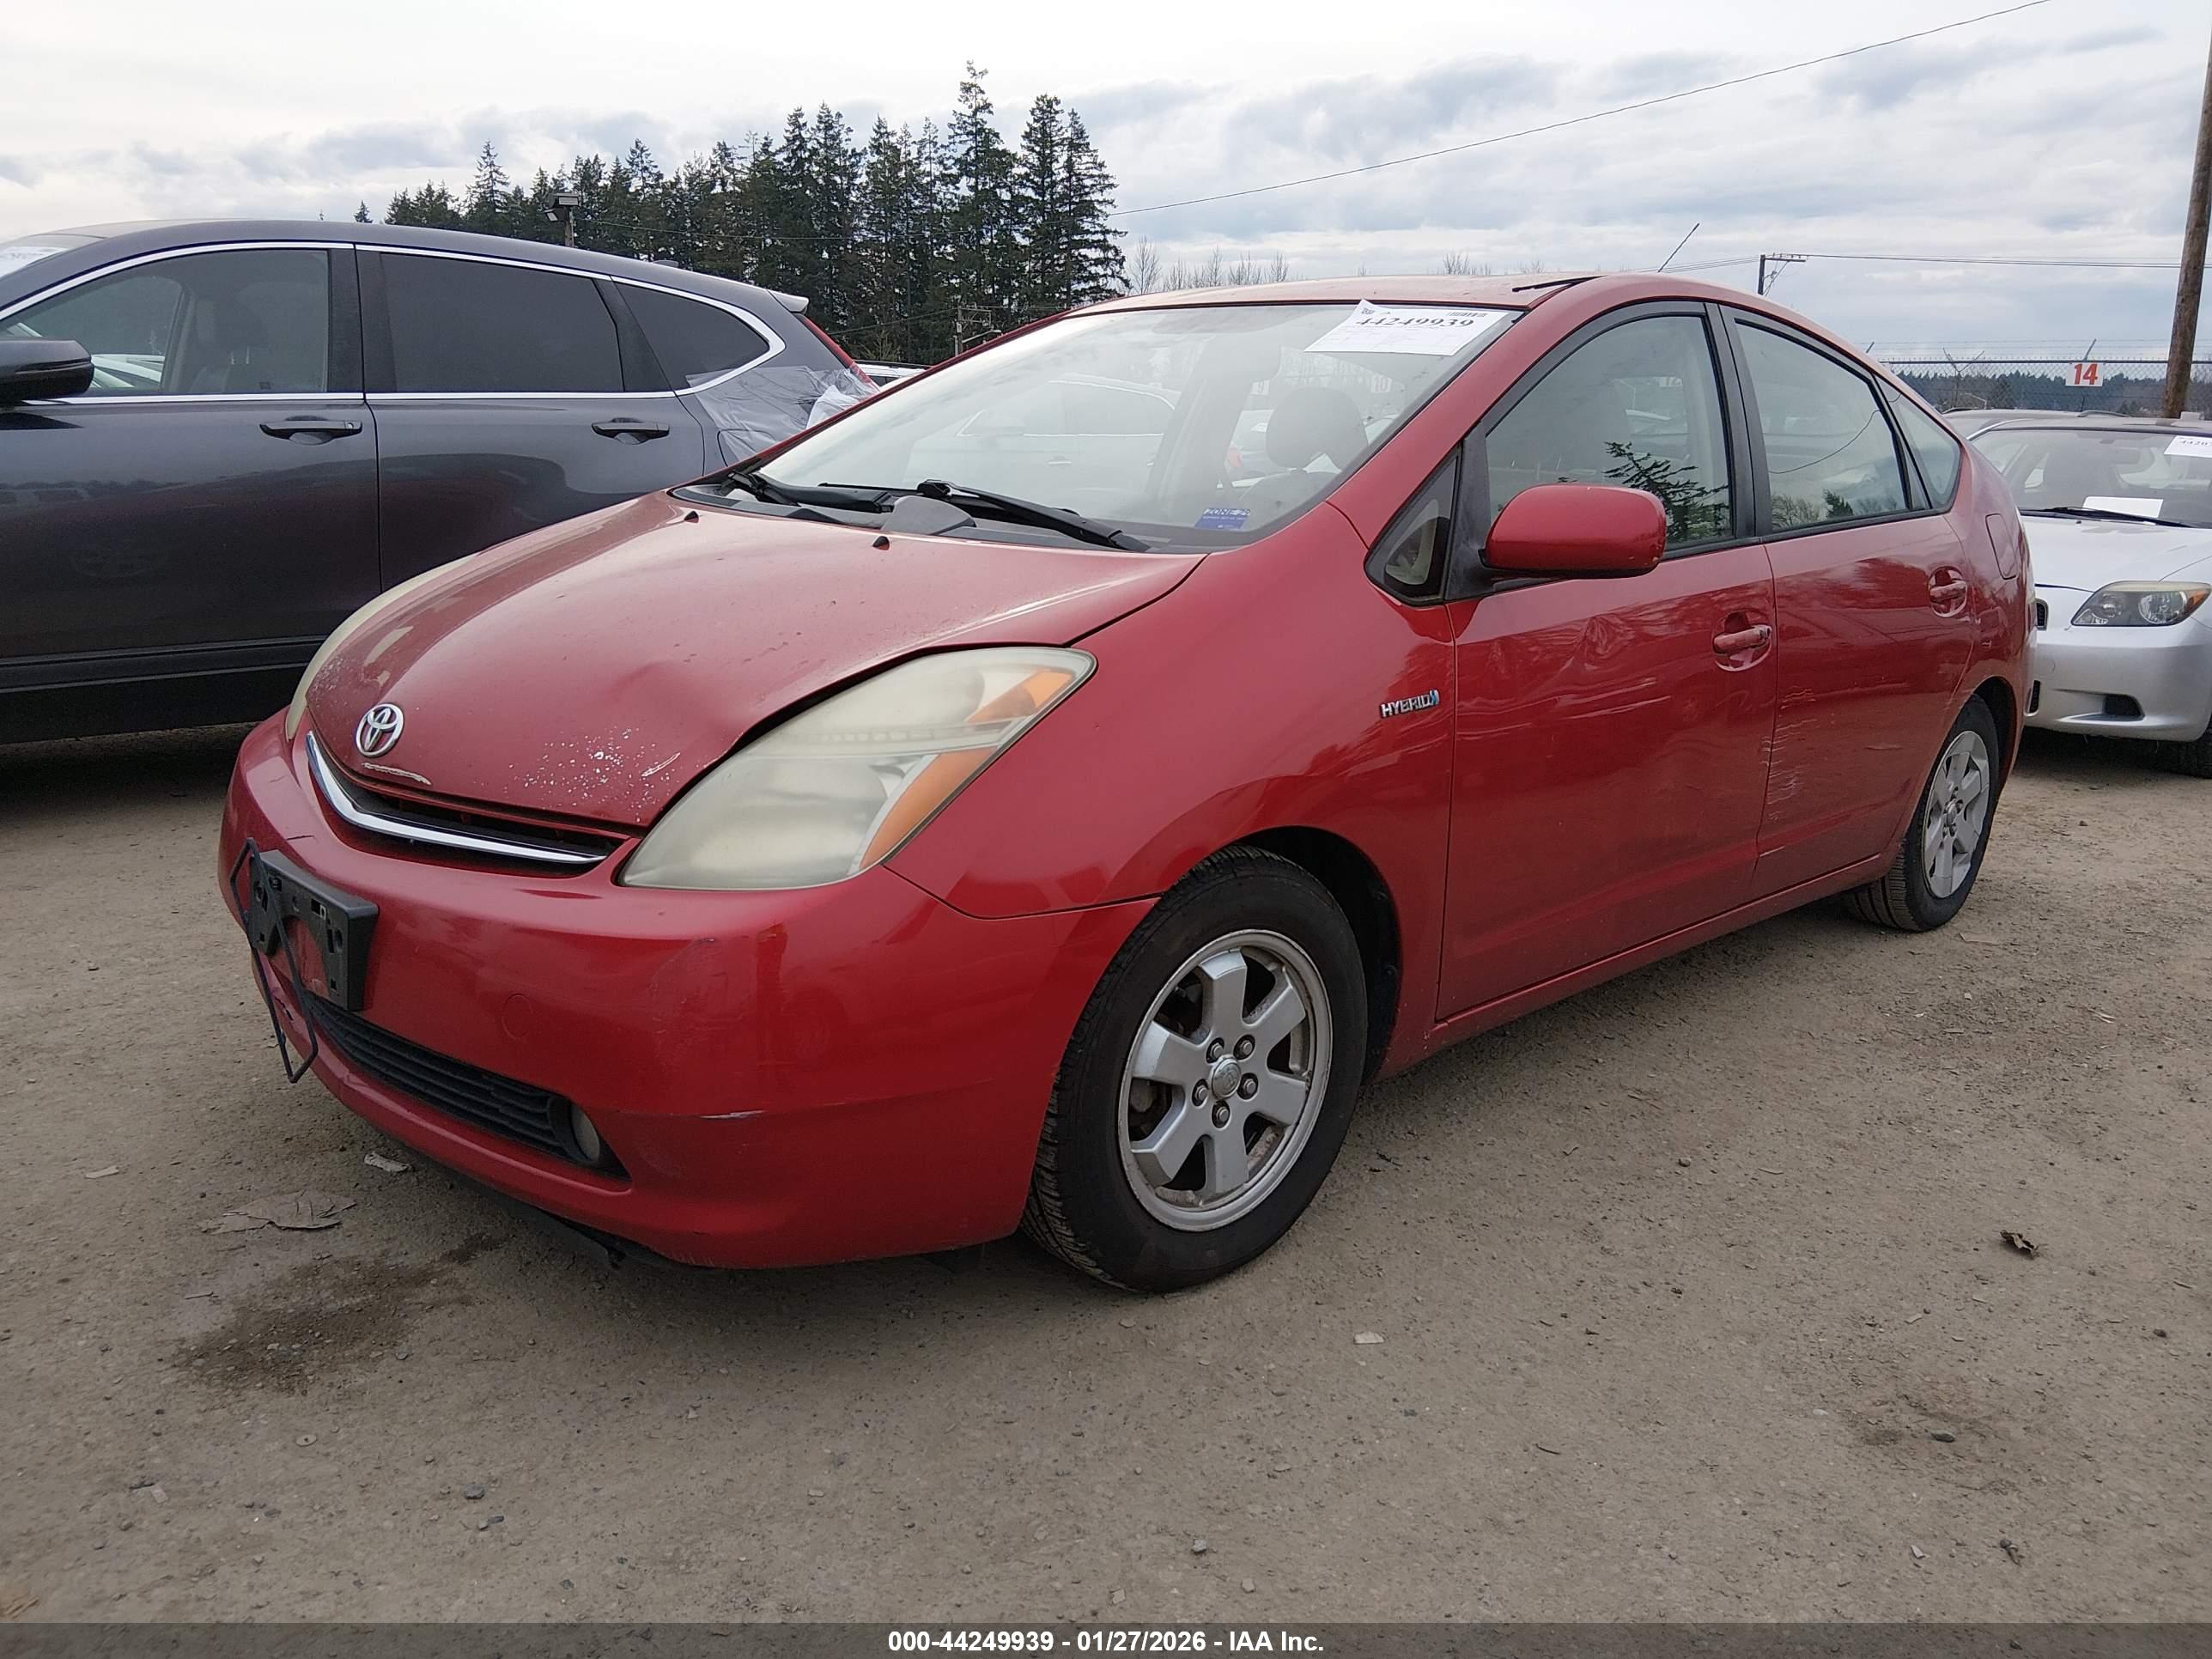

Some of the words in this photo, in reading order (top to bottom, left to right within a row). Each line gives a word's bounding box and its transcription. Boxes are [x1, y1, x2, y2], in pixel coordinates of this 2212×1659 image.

[1355, 317, 1475, 327] 44249939
[1374, 375, 1389, 392] 10
[2074, 363, 2098, 385] 14
[1380, 694, 1432, 718] HYBRID
